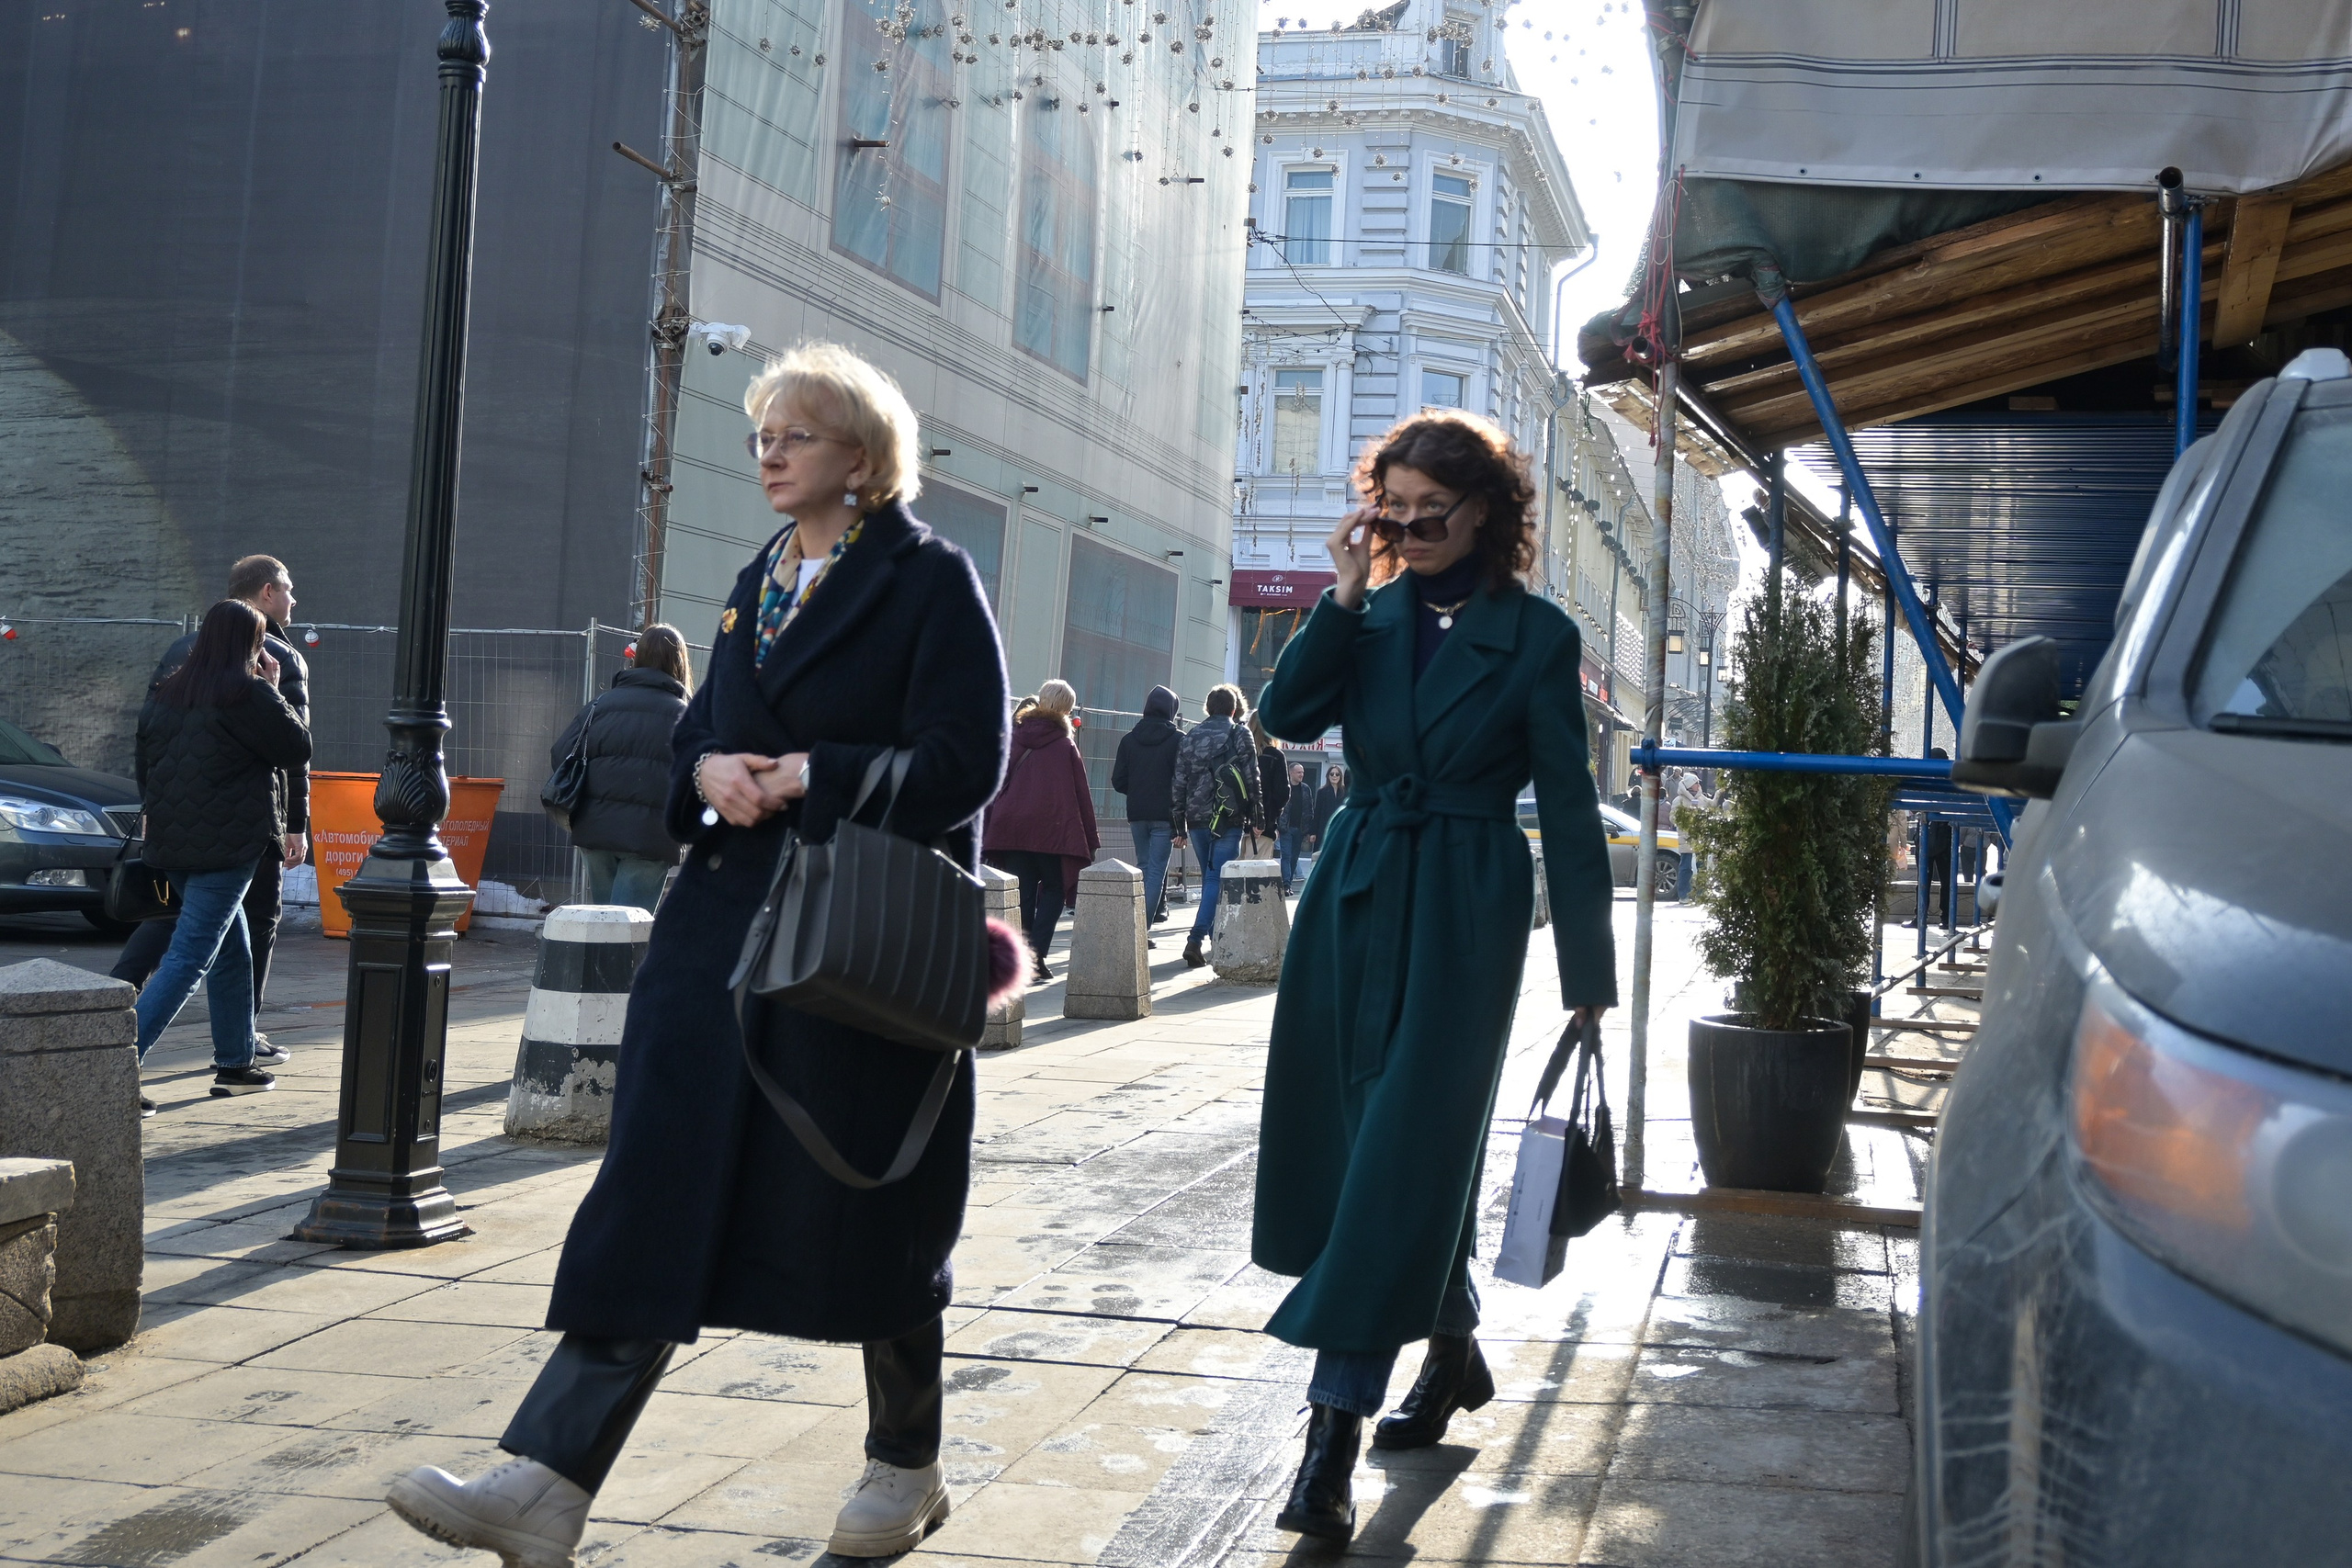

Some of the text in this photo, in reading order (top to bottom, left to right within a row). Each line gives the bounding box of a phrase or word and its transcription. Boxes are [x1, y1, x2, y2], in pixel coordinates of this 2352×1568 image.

[1257, 584, 1294, 593] TAKSIM
[325, 851, 364, 866] дороги
[335, 867, 354, 878] (495)
